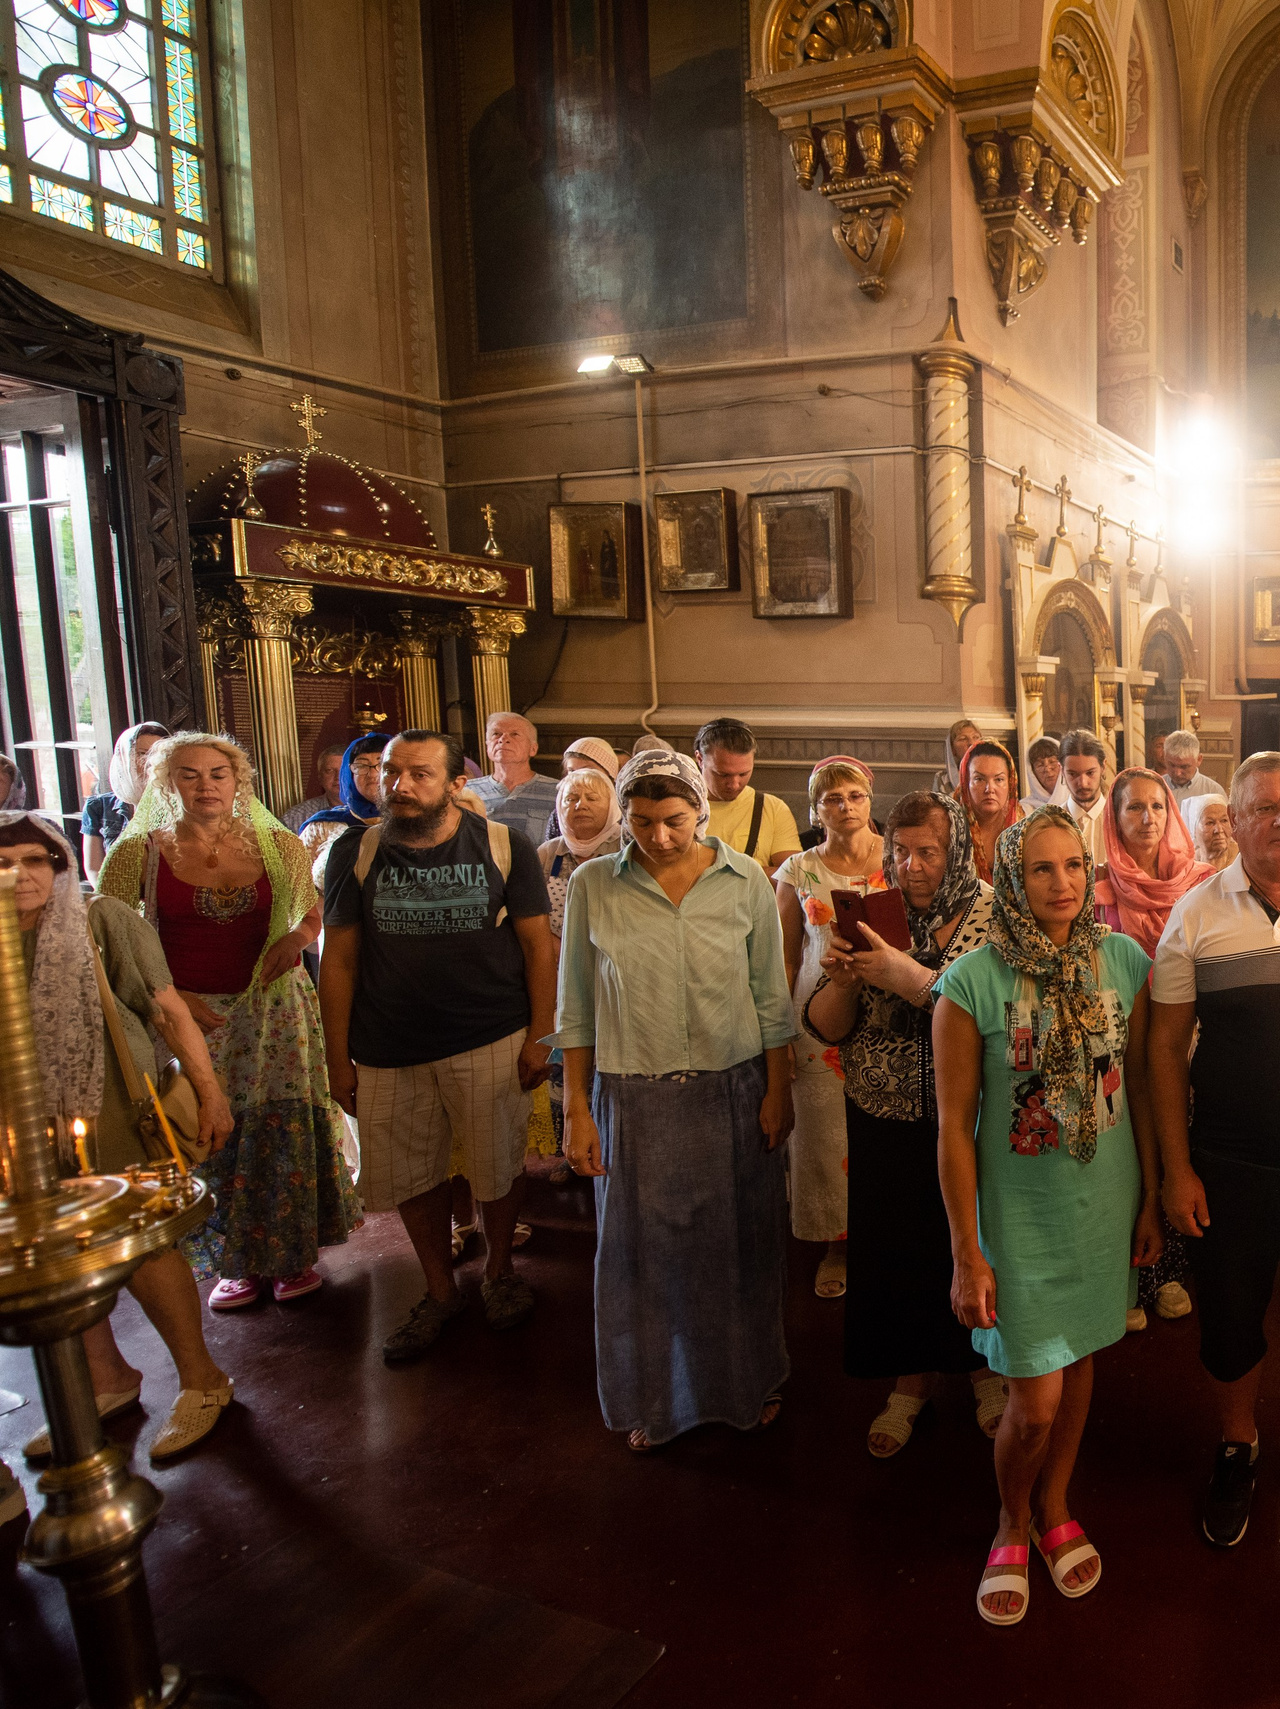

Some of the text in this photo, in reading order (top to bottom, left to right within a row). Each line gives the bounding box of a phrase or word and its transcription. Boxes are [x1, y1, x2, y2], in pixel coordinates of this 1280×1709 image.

[376, 863, 489, 888] CALIFORNIA
[376, 918, 483, 932] SURFING CHALLENGE
